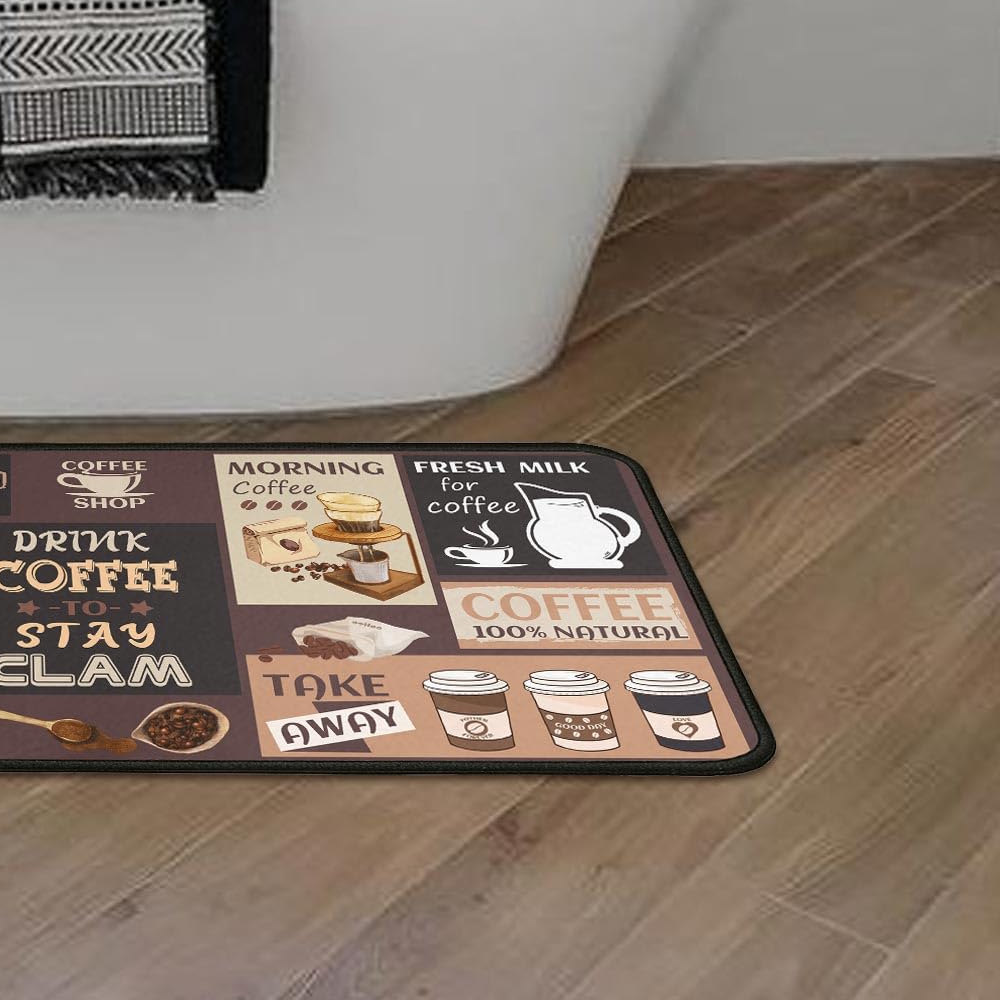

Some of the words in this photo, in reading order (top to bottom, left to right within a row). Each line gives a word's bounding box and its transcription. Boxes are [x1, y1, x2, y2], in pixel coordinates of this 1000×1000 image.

[61, 460, 148, 472] COFFEE
[228, 461, 385, 475] MORNING
[413, 461, 506, 473] FRESH
[519, 461, 591, 474] MILK
[232, 479, 317, 495] Coffee
[441, 477, 479, 492] for
[73, 497, 146, 509] SHOP
[427, 496, 521, 514] coffee
[13, 530, 150, 552] DRINK
[460, 592, 673, 621] COFFEE
[16, 621, 156, 649] STAY
[472, 625, 547, 639] 100%
[555, 625, 689, 641] NATURAL
[262, 673, 389, 701] TAKE
[280, 705, 398, 746] AWAY
[555, 722, 585, 731] GOOD
[588, 722, 607, 730] DAY
